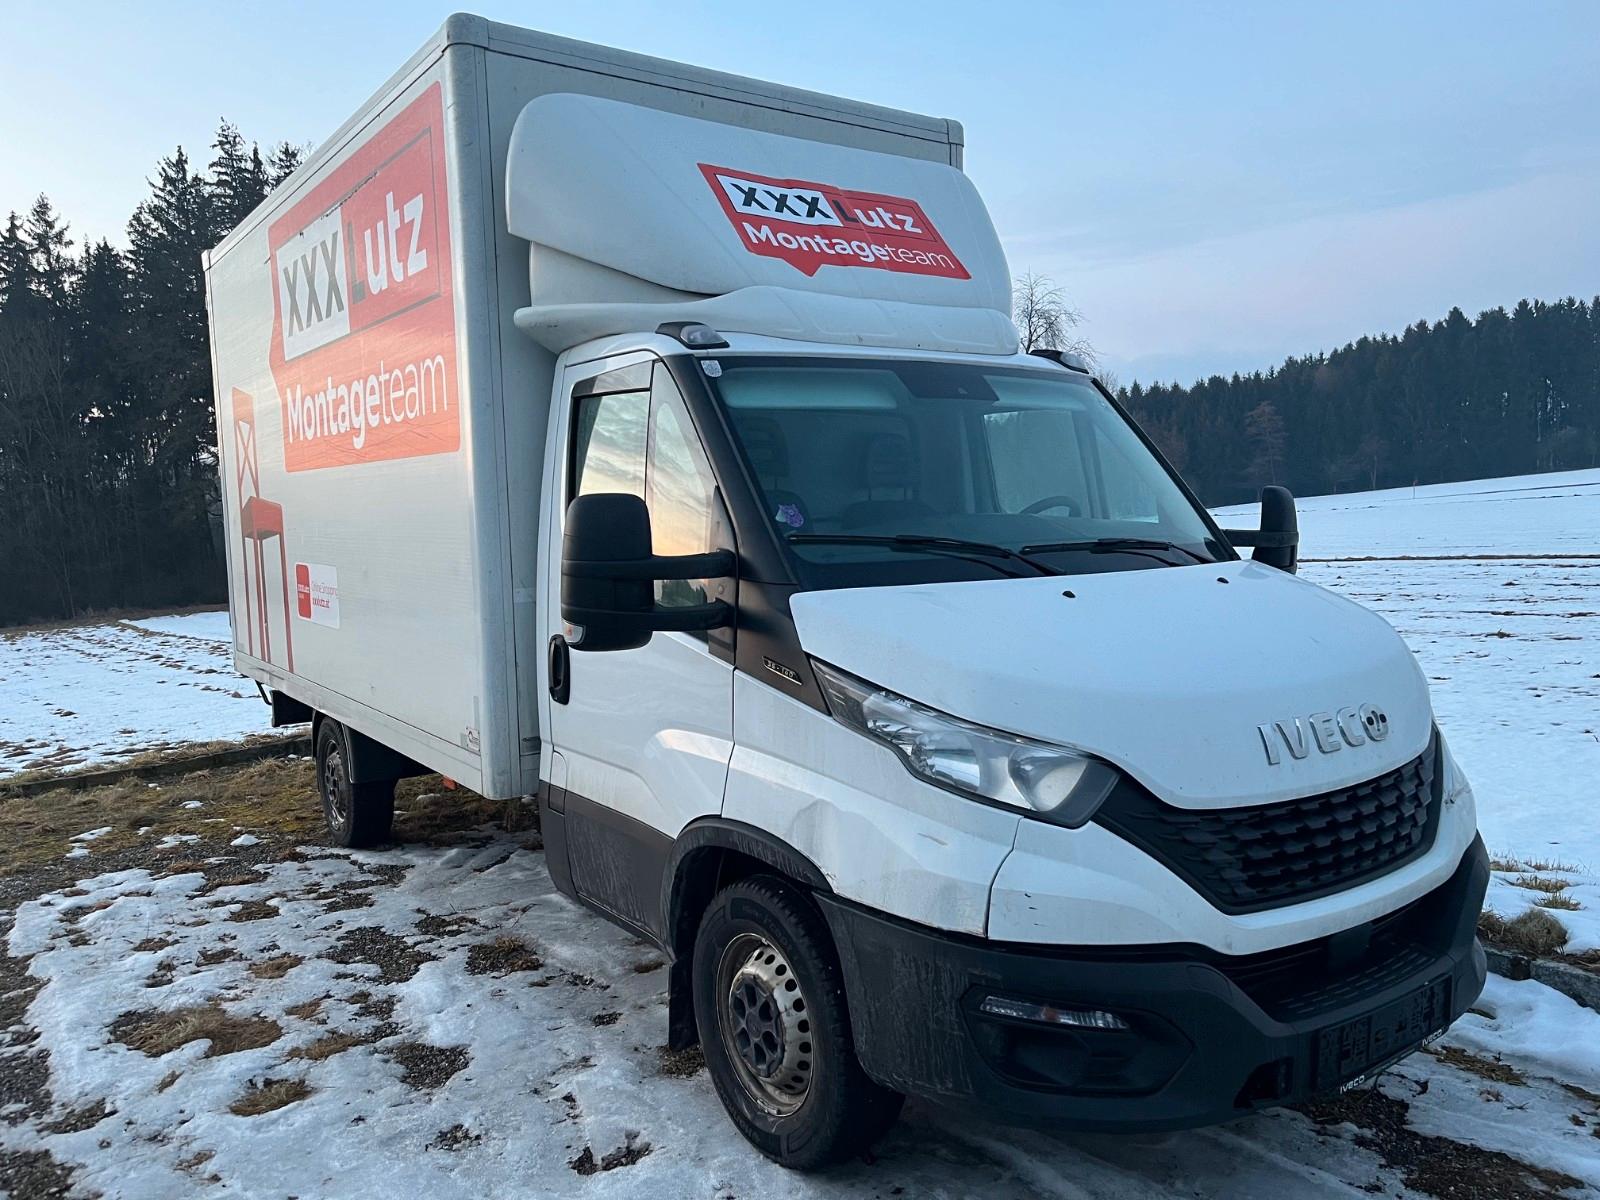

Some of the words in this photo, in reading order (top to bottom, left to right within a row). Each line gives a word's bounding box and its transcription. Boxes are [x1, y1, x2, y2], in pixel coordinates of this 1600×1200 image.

[730, 182, 923, 234] XXXLutz
[282, 191, 428, 337] XXXLutz
[742, 221, 955, 270] Montageteam
[286, 353, 447, 449] Montageteam
[1257, 703, 1390, 765] IVECO
[1422, 1029, 1443, 1046] IVECO
[1340, 1075, 1365, 1094] IVECO
